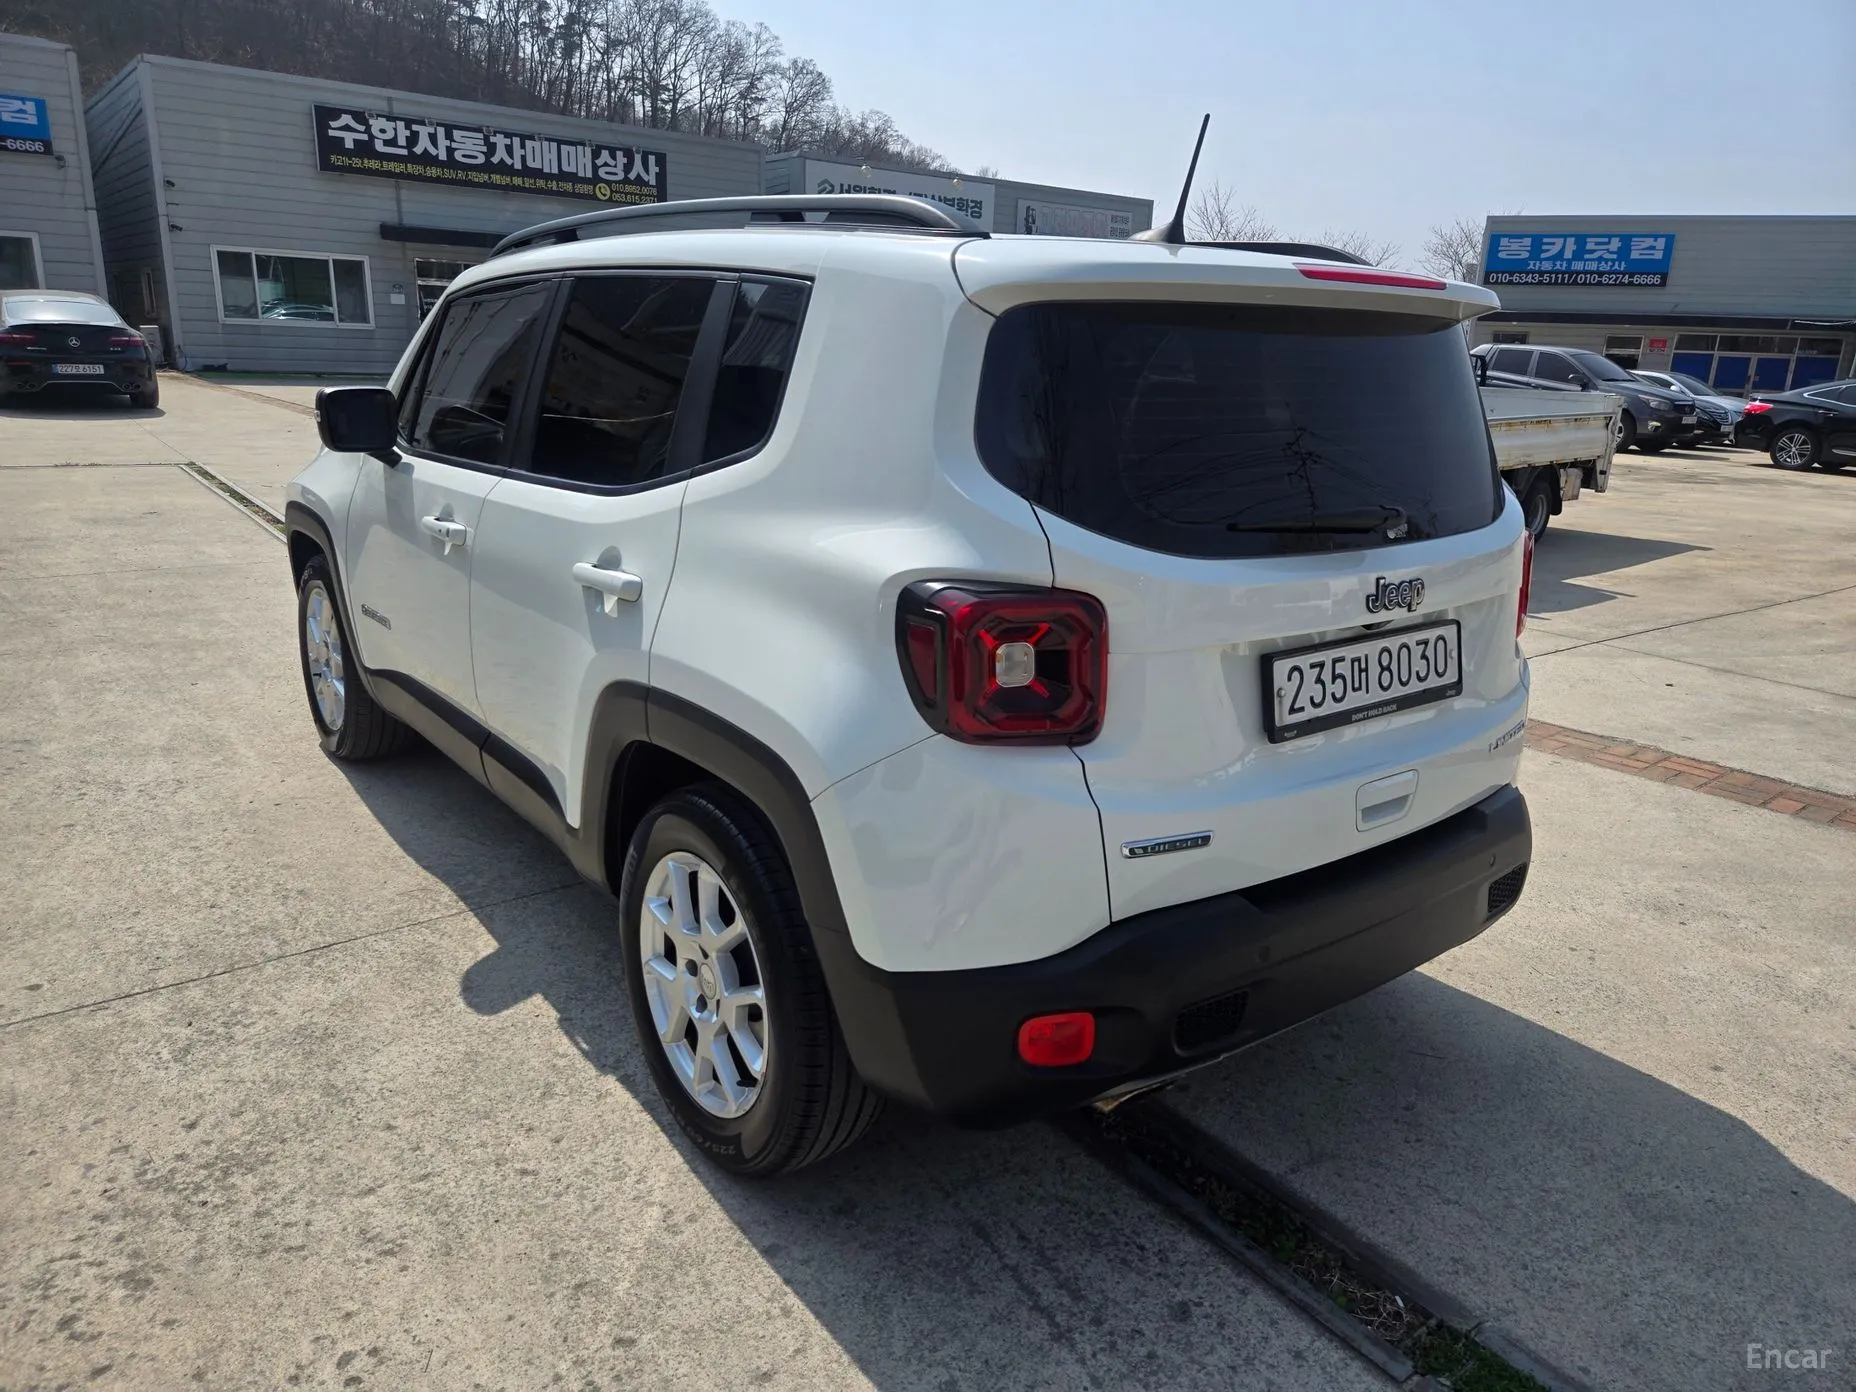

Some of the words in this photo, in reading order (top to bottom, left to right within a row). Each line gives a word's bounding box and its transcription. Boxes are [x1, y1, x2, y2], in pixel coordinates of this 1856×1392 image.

[328, 113, 660, 186] 수한자동차매매상사
[1526, 260, 1568, 271] 자동차
[1570, 260, 1626, 271] 매매상사
[1366, 577, 1426, 613] Jeep
